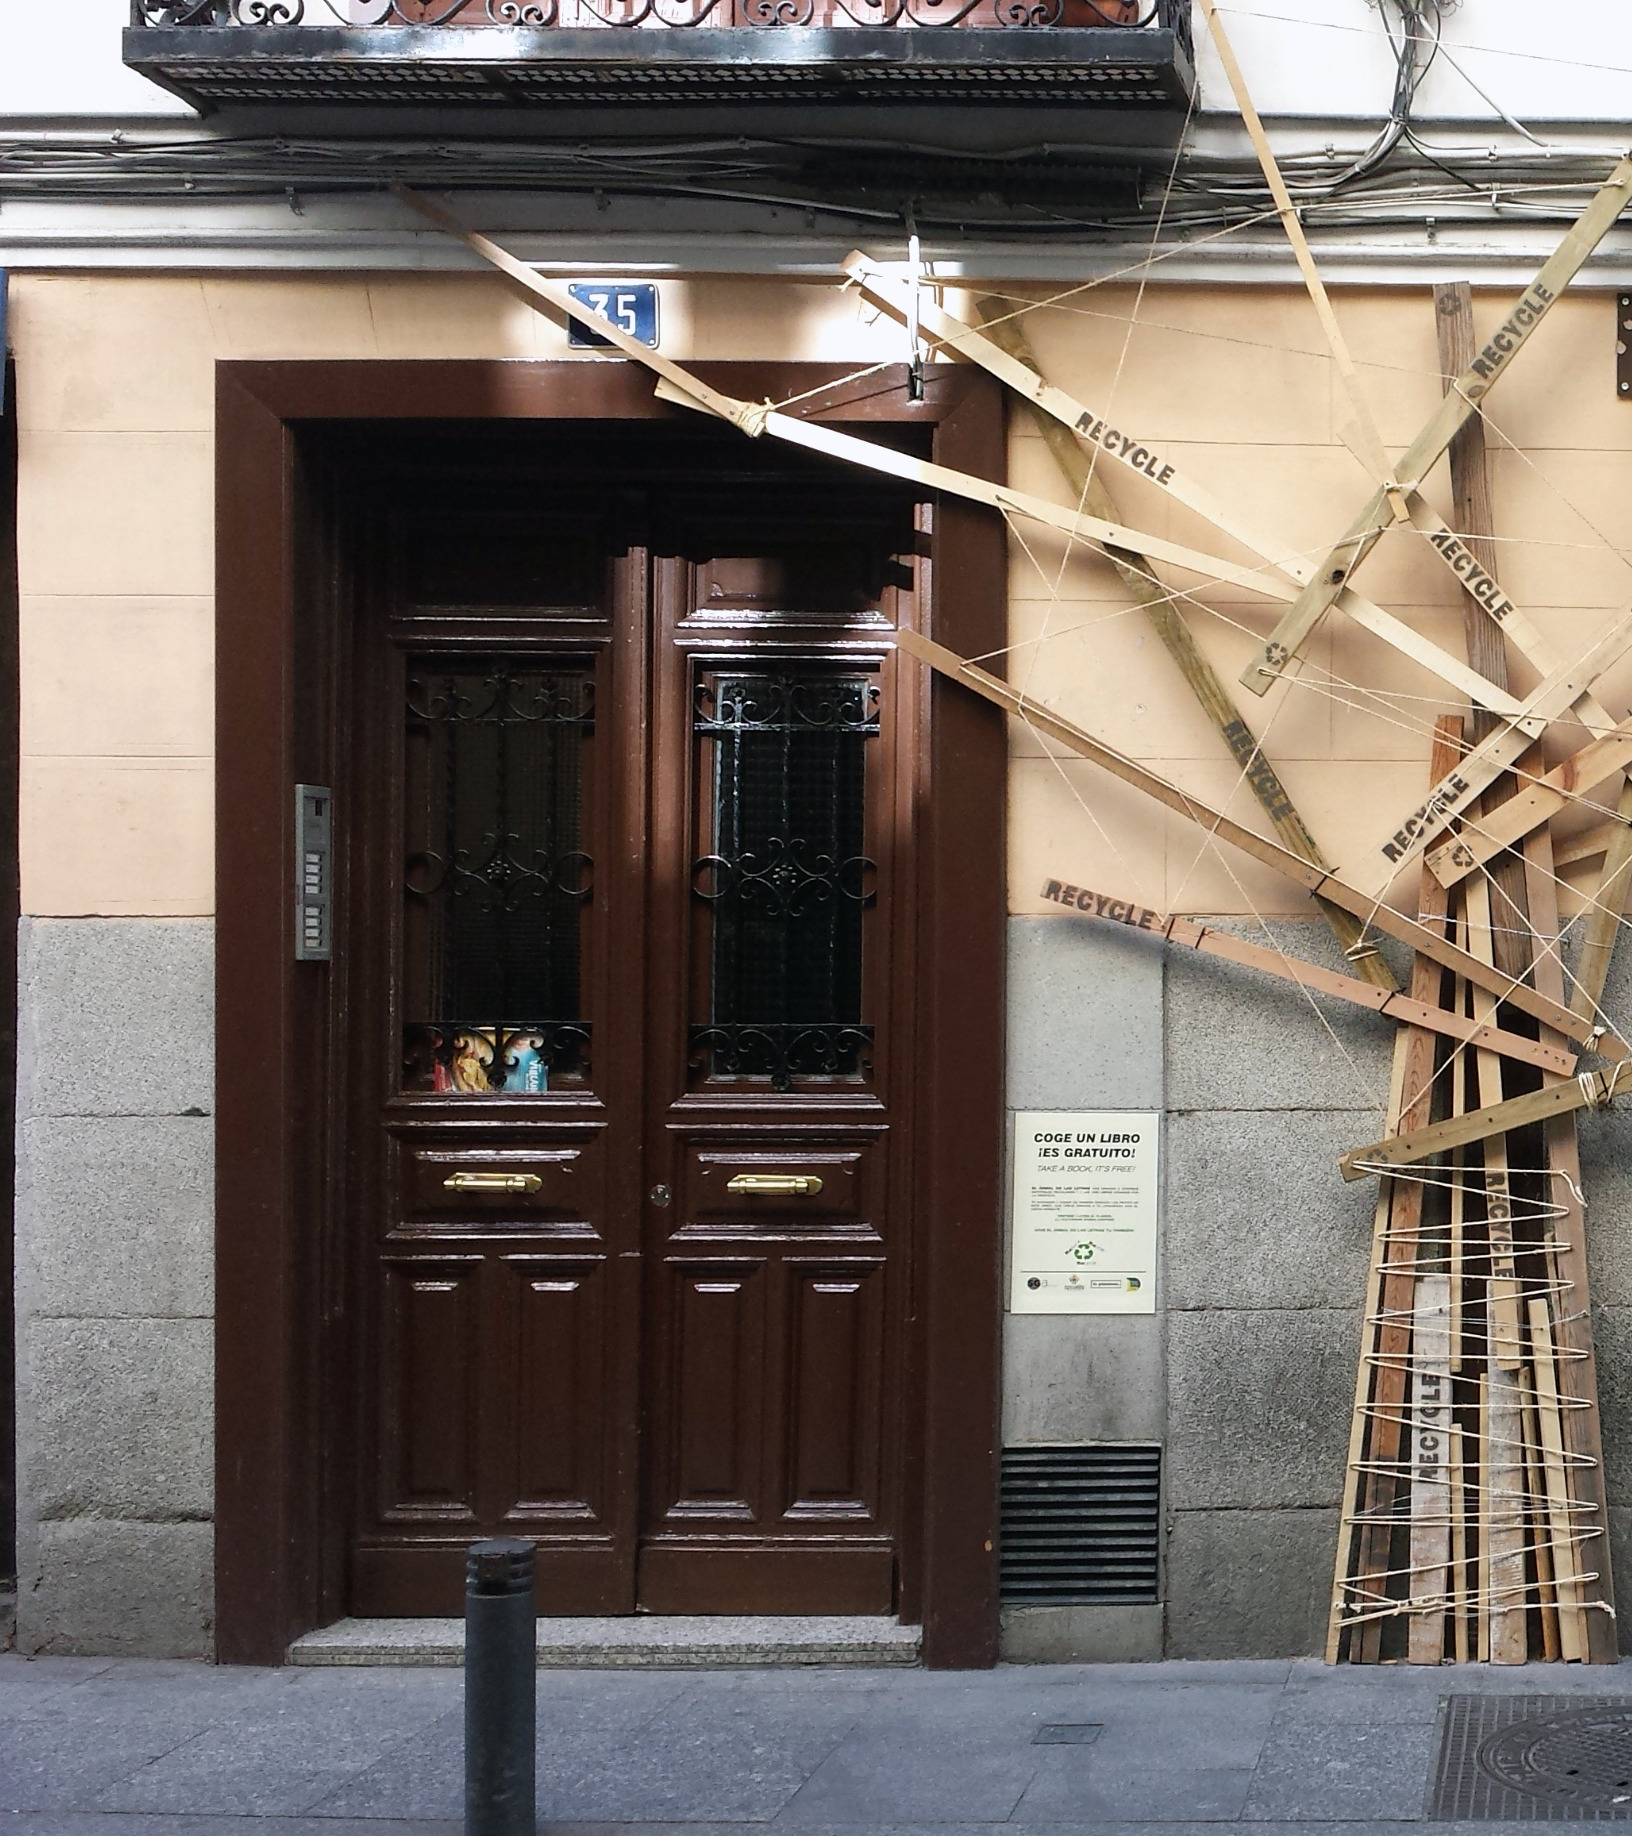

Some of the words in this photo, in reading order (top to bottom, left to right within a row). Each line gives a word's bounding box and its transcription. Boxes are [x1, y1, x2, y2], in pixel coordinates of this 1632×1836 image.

[588, 293, 637, 335] 35
[1470, 282, 1555, 381] RECYCLE
[1074, 410, 1176, 487] RECYCLE
[1430, 528, 1514, 622] RECYCLE
[1222, 720, 1296, 822] RECYCLE
[1046, 880, 1154, 930] RECYCLE
[1034, 1133, 1072, 1143] COGE
[1077, 1133, 1096, 1143] UN
[1100, 1133, 1141, 1143] LIBRO
[1038, 1148, 1060, 1157] ¡ES
[1064, 1148, 1136, 1158] GRATUITO!
[1111, 1165, 1136, 1173] FREE!
